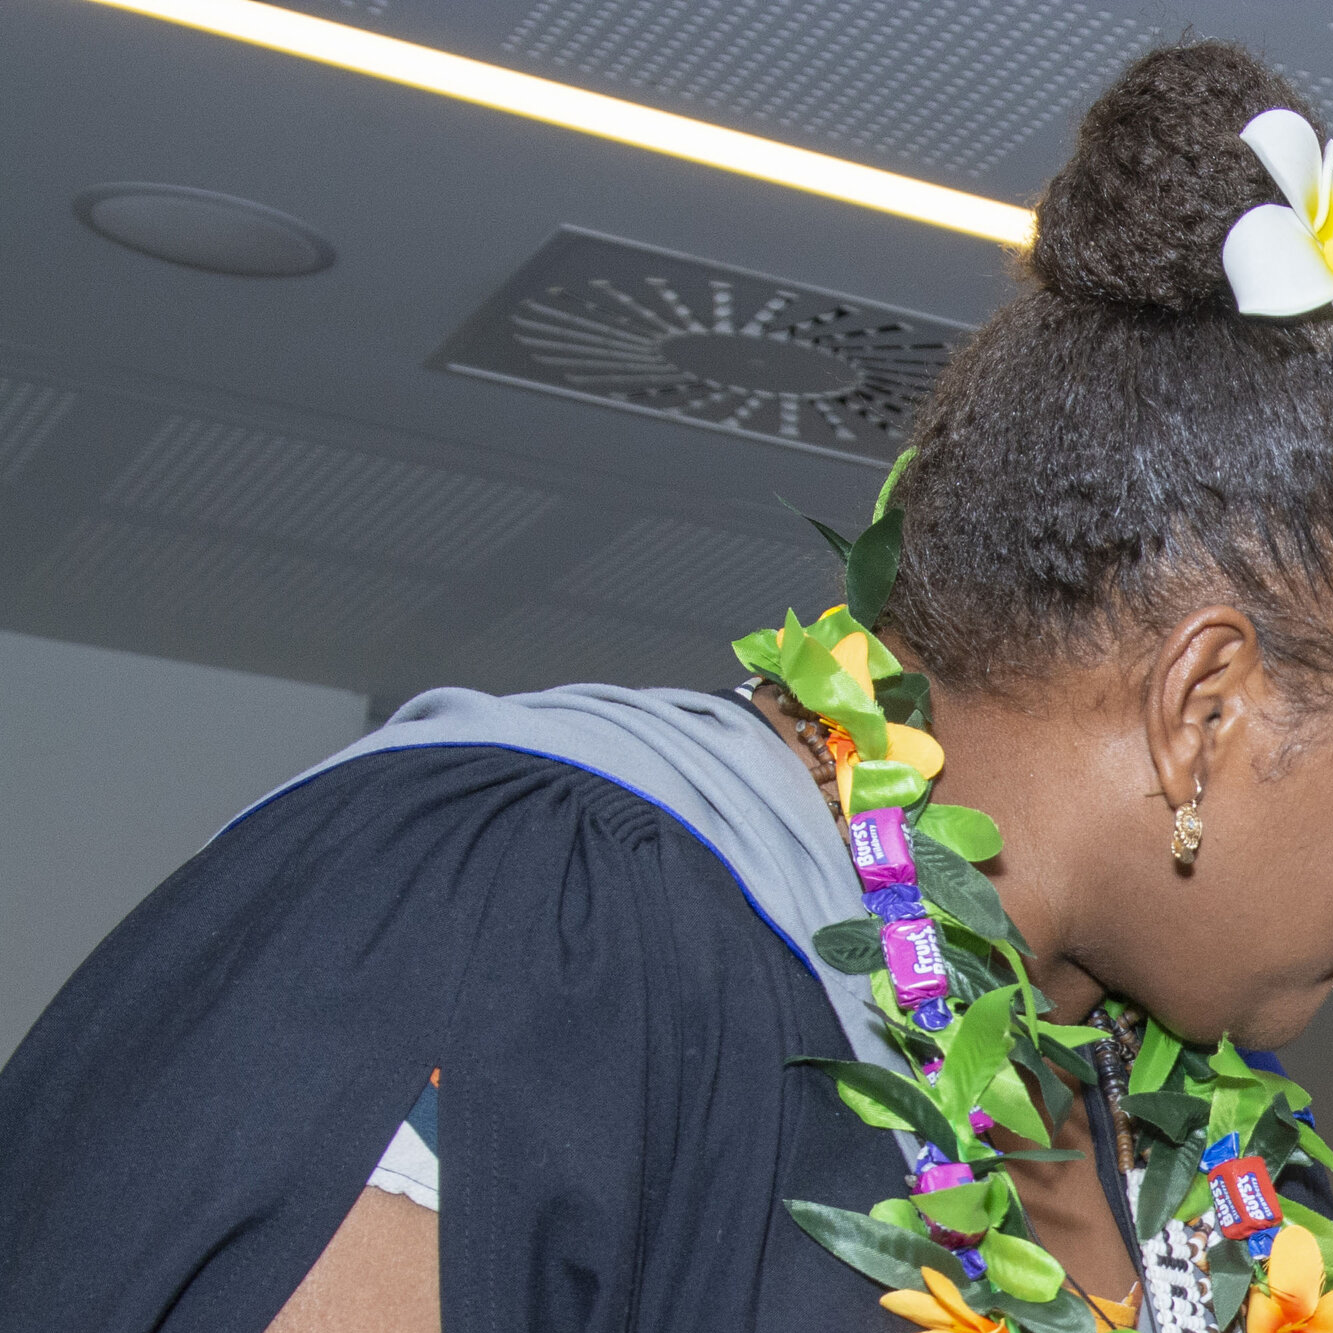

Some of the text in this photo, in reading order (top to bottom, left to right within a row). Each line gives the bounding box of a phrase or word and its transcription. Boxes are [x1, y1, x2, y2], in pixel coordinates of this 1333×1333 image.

[851, 821, 875, 867] Burst
[869, 824, 885, 860] Wildberry
[906, 932, 934, 975] Fruit
[1209, 1178, 1234, 1227] Burst
[1220, 1180, 1241, 1220] Strawberry
[1237, 1174, 1265, 1220] Burst
[1251, 1177, 1273, 1219] Strawberry
